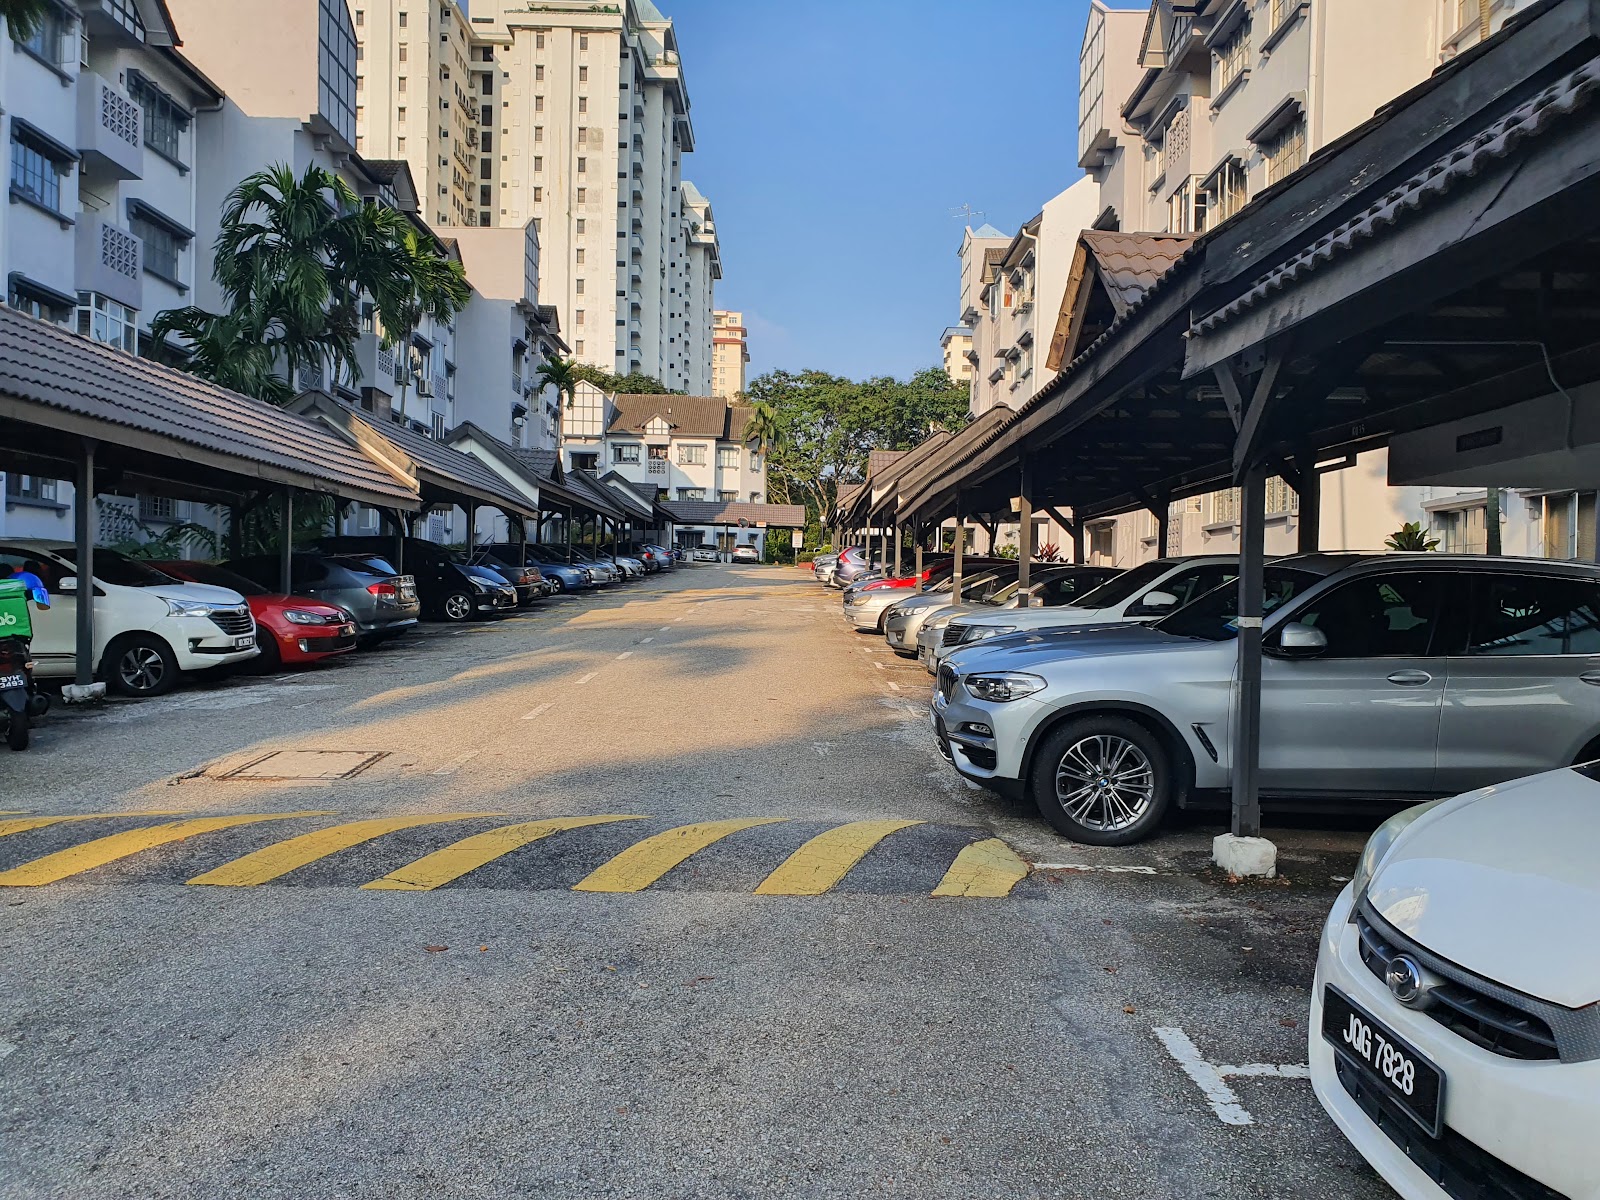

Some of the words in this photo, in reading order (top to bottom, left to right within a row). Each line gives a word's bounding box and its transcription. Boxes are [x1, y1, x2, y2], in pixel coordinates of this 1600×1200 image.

[0, 680, 24, 689] 3493
[1343, 1013, 1372, 1062] JQG
[1375, 1033, 1415, 1096] 7828
